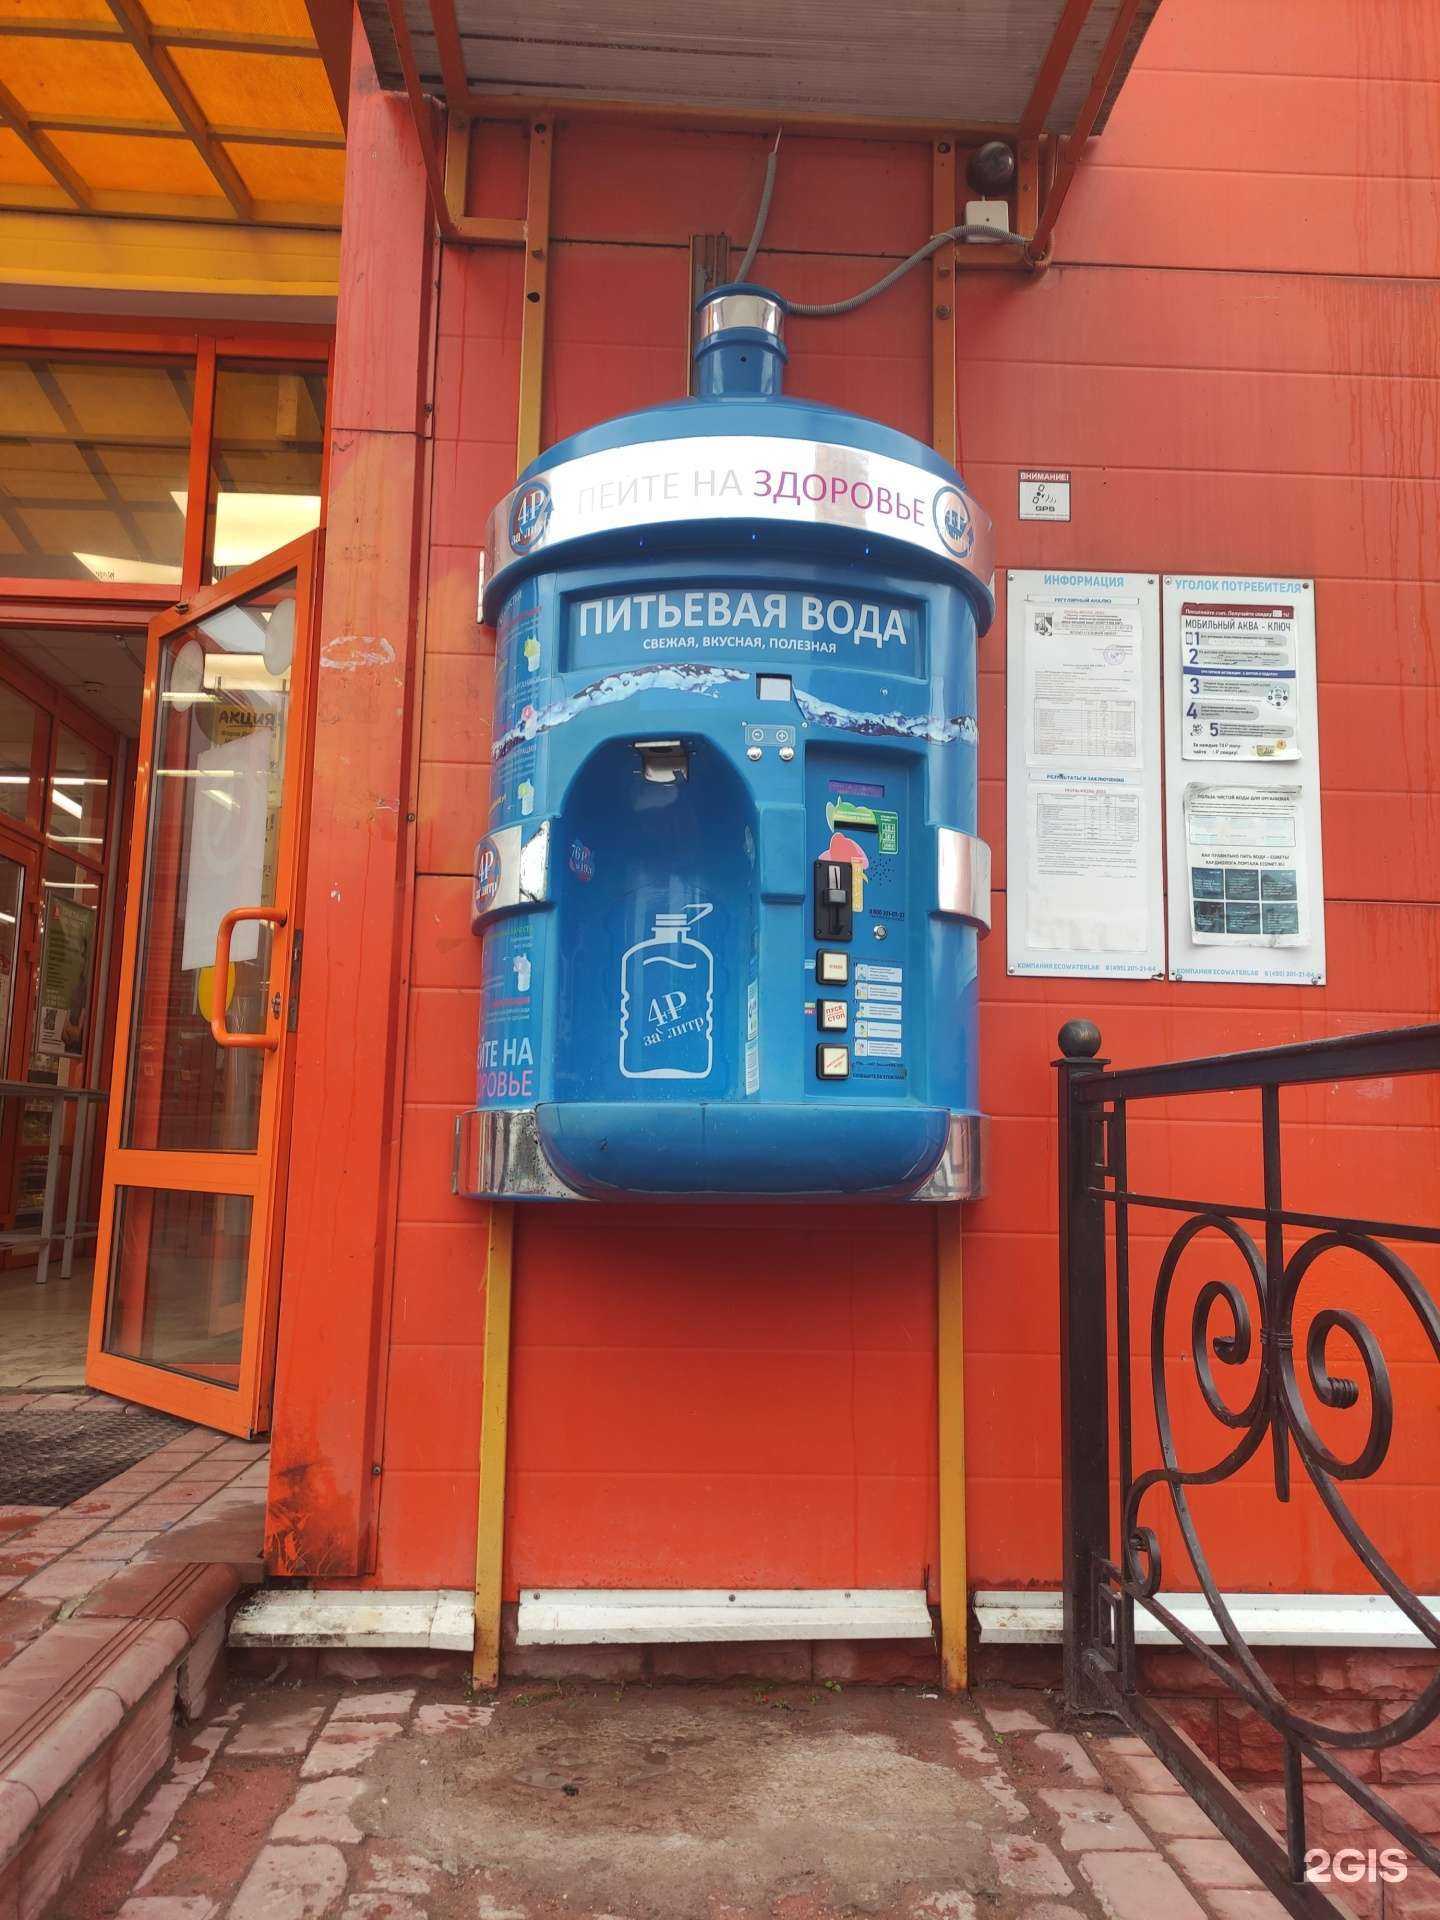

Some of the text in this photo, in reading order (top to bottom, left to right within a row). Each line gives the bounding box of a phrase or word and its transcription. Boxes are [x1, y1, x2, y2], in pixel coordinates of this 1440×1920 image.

[694, 469, 743, 497] НА
[753, 469, 925, 527] ЗДОРОВЬЕ
[1044, 574, 1125, 588] ИНФОРМАЦИЯ
[1175, 579, 1302, 594] УГОЛОК ПОТРЕБИТЕЛЯ
[579, 591, 787, 637] ПИТЬЕВАЯ
[801, 596, 907, 649] ВОДА
[1185, 619, 1235, 630] МОБИЛЬНЫЙ
[1238, 621, 1259, 631] АКВА
[1268, 622, 1291, 632] КЛЮЧ
[643, 635, 837, 654] СВЕЖАЯ, ВКУСНАЯ, ПОЛЕЗНАЯ
[1194, 632, 1200, 646] 1
[1188, 648, 1199, 664] 2
[1190, 678, 1200, 694] 3
[218, 709, 275, 726] АКЦИЯ
[1186, 702, 1198, 720] 4
[1210, 722, 1219, 736] 5
[643, 1016, 704, 1047] за литр
[502, 1037, 533, 1067] НА
[479, 1069, 533, 1098] РОВЬЕ
